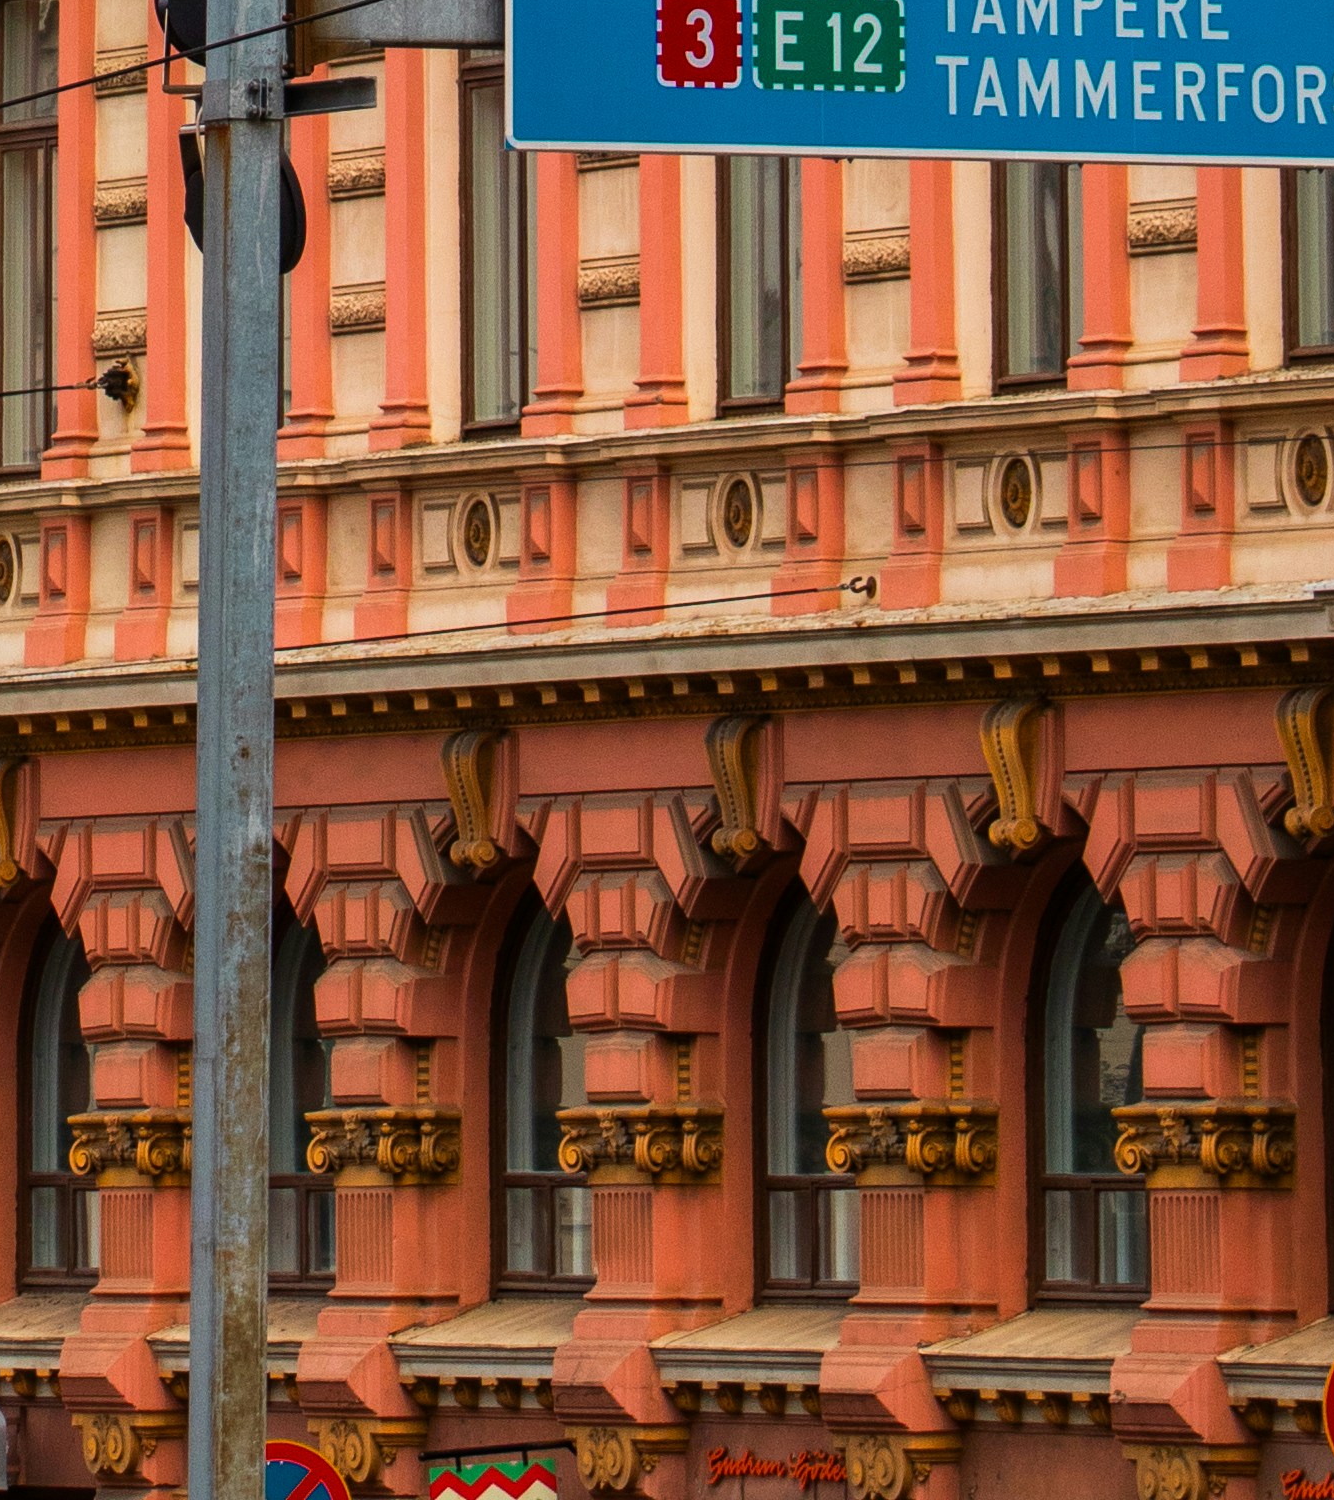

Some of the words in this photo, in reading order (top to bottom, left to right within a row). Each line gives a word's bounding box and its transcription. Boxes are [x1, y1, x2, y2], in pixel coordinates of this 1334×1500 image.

[685, 9, 714, 69] 3
[775, 12, 805, 72] E
[827, 13, 883, 74] 12
[707, 1447, 787, 1485] Gudrun
